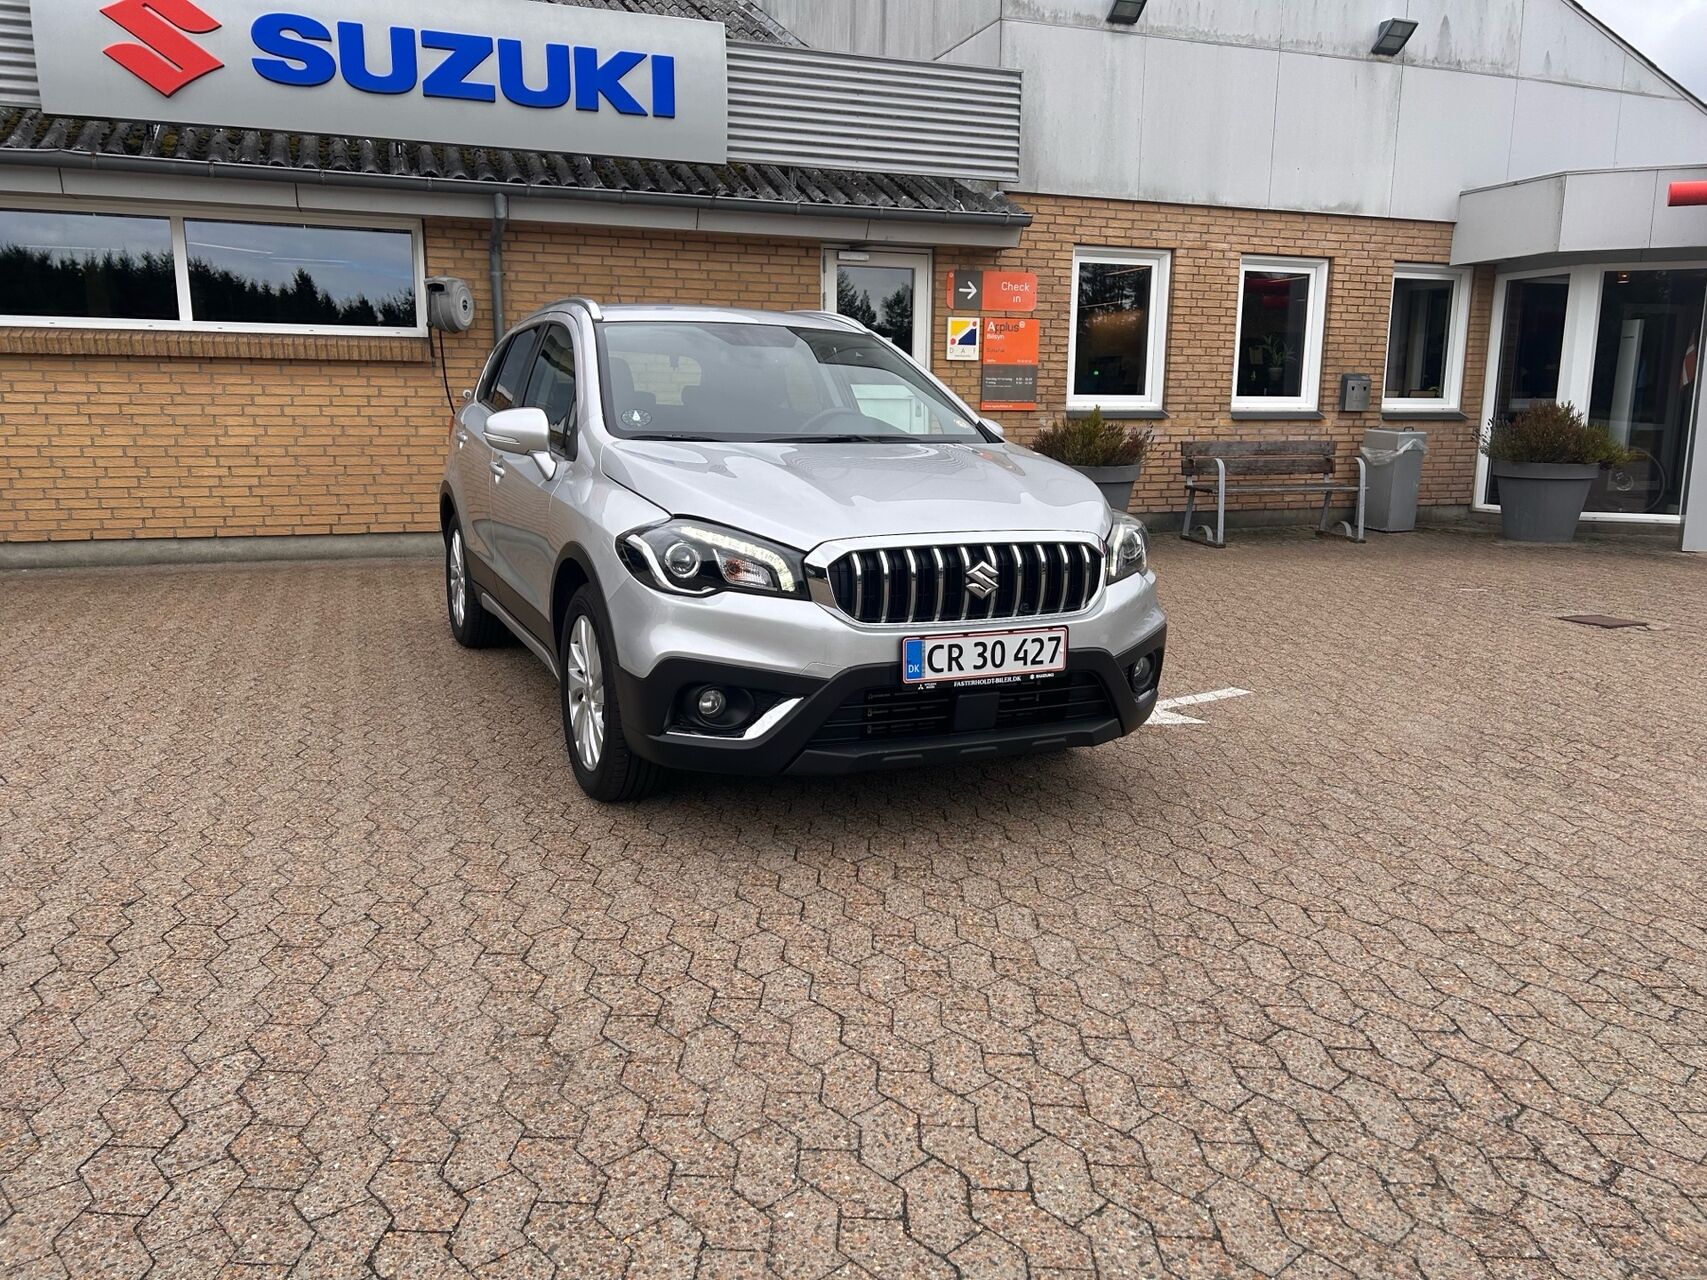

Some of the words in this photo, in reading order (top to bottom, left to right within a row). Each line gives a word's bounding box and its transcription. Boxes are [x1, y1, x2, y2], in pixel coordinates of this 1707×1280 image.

[250, 12, 676, 119] SUZUKI
[1001, 281, 1030, 292] Check
[1012, 295, 1021, 303] in
[908, 664, 920, 673] DK
[927, 643, 965, 673] CR
[973, 639, 1006, 670] 30
[1013, 636, 1062, 666] 427
